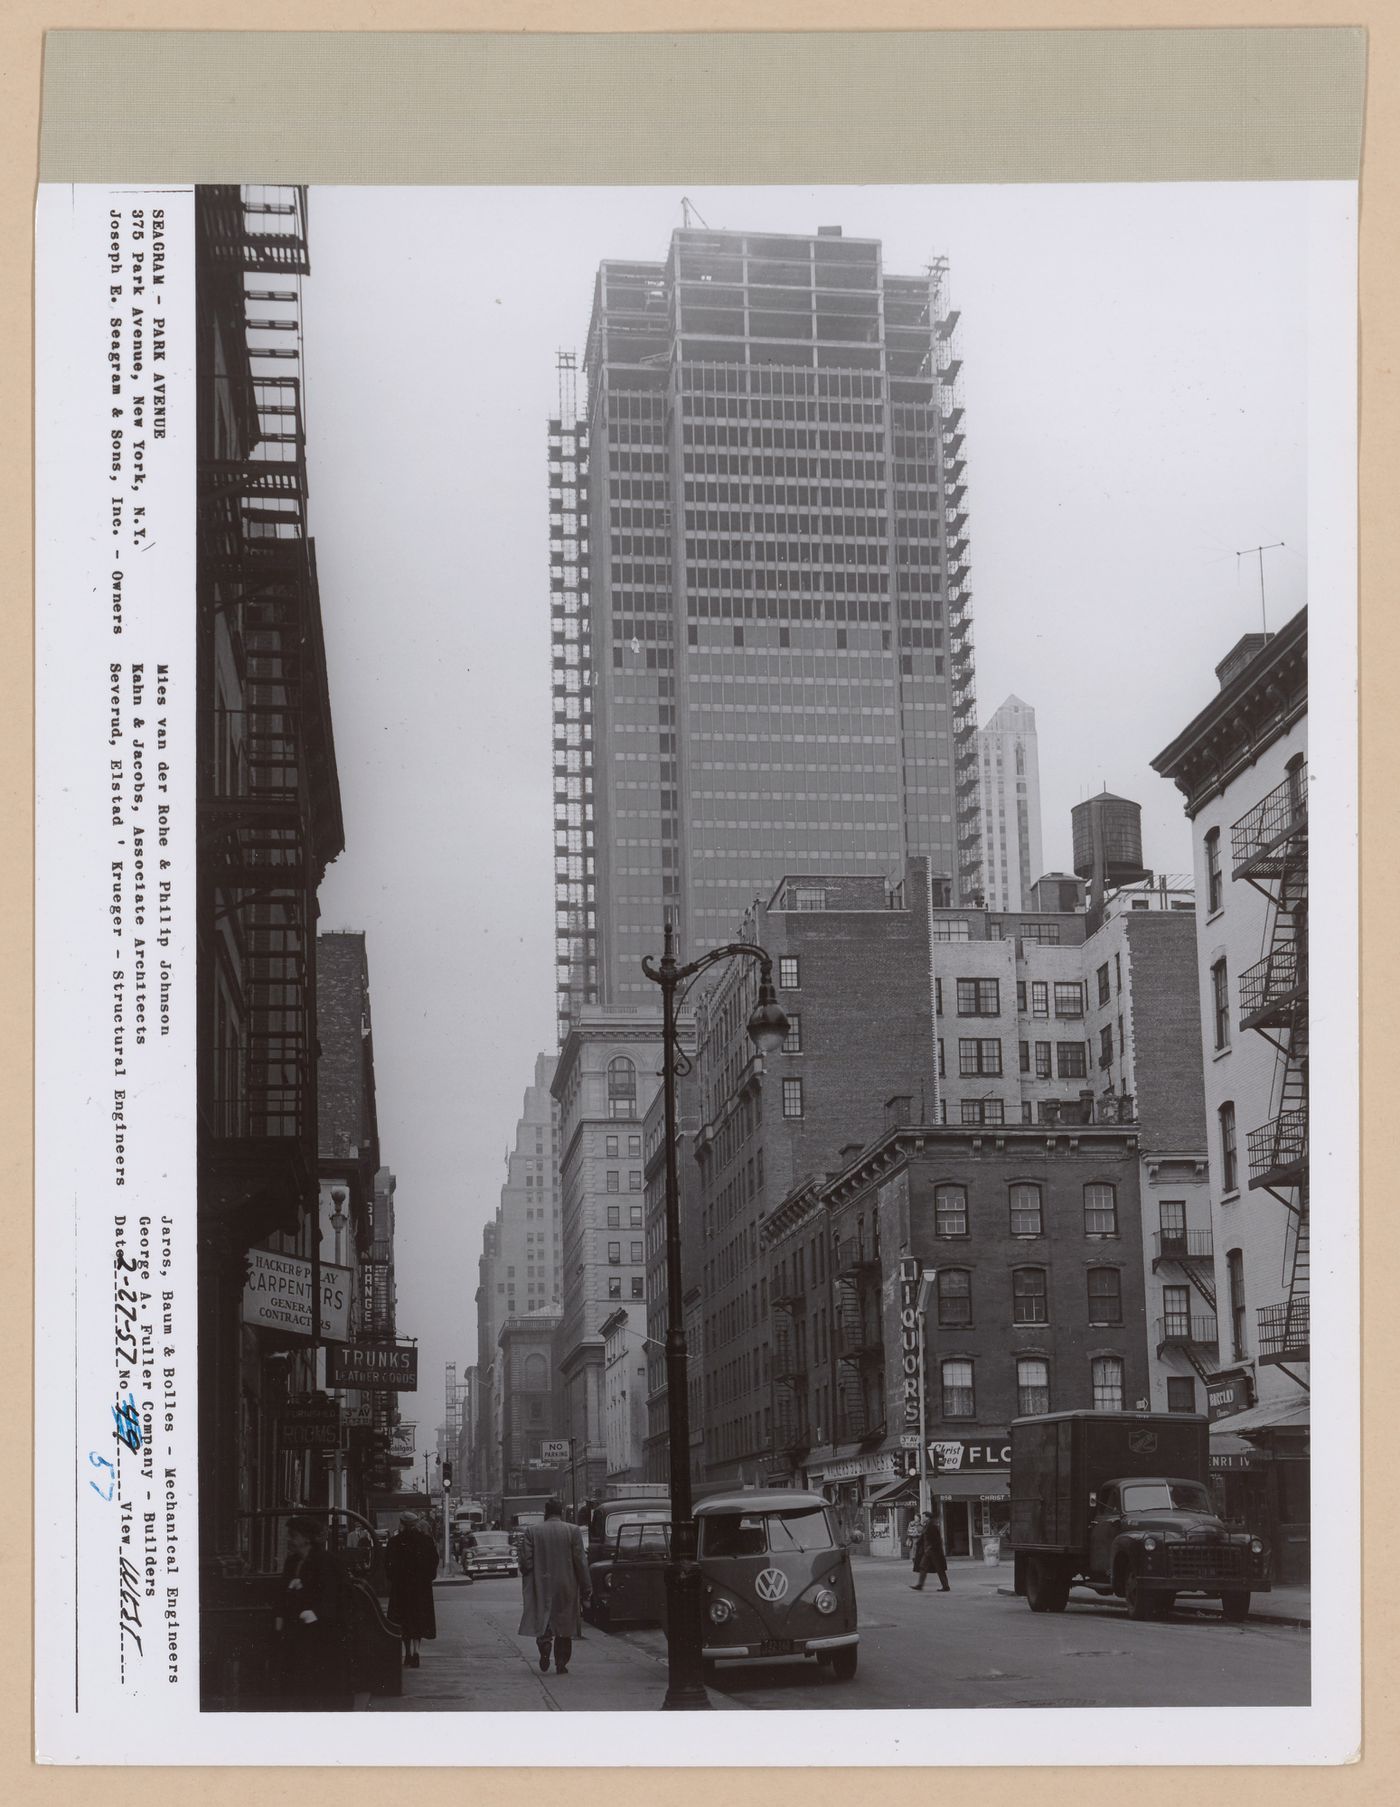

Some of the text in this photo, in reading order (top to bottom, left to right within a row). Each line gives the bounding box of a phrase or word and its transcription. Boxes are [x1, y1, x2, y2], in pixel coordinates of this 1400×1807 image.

[107, 209, 123, 274] Joseph
[152, 209, 165, 285] SEAGRAM
[110, 285, 122, 303] E.
[107, 318, 123, 395] Seagram
[153, 318, 166, 361] PARK
[130, 209, 146, 546] 375 Park Avenue, New York, N.Y.
[153, 372, 166, 439] AVENUE
[111, 407, 124, 418] &
[109, 429, 123, 481] Sons,
[111, 497, 124, 536] Inc.
[111, 570, 124, 635] Owners
[108, 663, 123, 746] Severud,
[156, 664, 169, 706] Mies
[157, 717, 167, 750] van
[110, 759, 124, 826] Elstad
[157, 761, 170, 793] der
[158, 804, 170, 847] Rohe
[131, 663, 147, 1045] Kahn & Jacobs, Associate Architects
[159, 859, 171, 870] &
[109, 861, 123, 937] Krueger
[112, 970, 126, 1076] Structural
[159, 960, 172, 1036] Johnson
[111, 1089, 127, 1186] Engineers
[137, 1215, 153, 1281] George
[159, 1215, 173, 1276] Jaros,
[255, 1255, 295, 1275] HACKER
[140, 1291, 152, 1310] A.
[162, 1291, 174, 1335] Baum
[248, 1271, 343, 1310] CARPENTRS
[259, 1307, 331, 1330] CONTRACTRS
[270, 1297, 312, 1314] GENERA
[140, 1324, 154, 1390] Fuller
[163, 1346, 176, 1357] &
[342, 1349, 411, 1369] TRUNKS
[900, 1261, 920, 1421] LIQUORS
[118, 1370, 131, 1390] No
[163, 1367, 177, 1432] Bolles
[335, 1370, 379, 1383] LEATHER
[140, 1400, 157, 1479] Company
[120, 1501, 133, 1545] View
[164, 1468, 179, 1574] Mechanical
[143, 1512, 157, 1597] Builders
[756, 1568, 788, 1600] VW
[164, 1587, 180, 1683] Engineers
